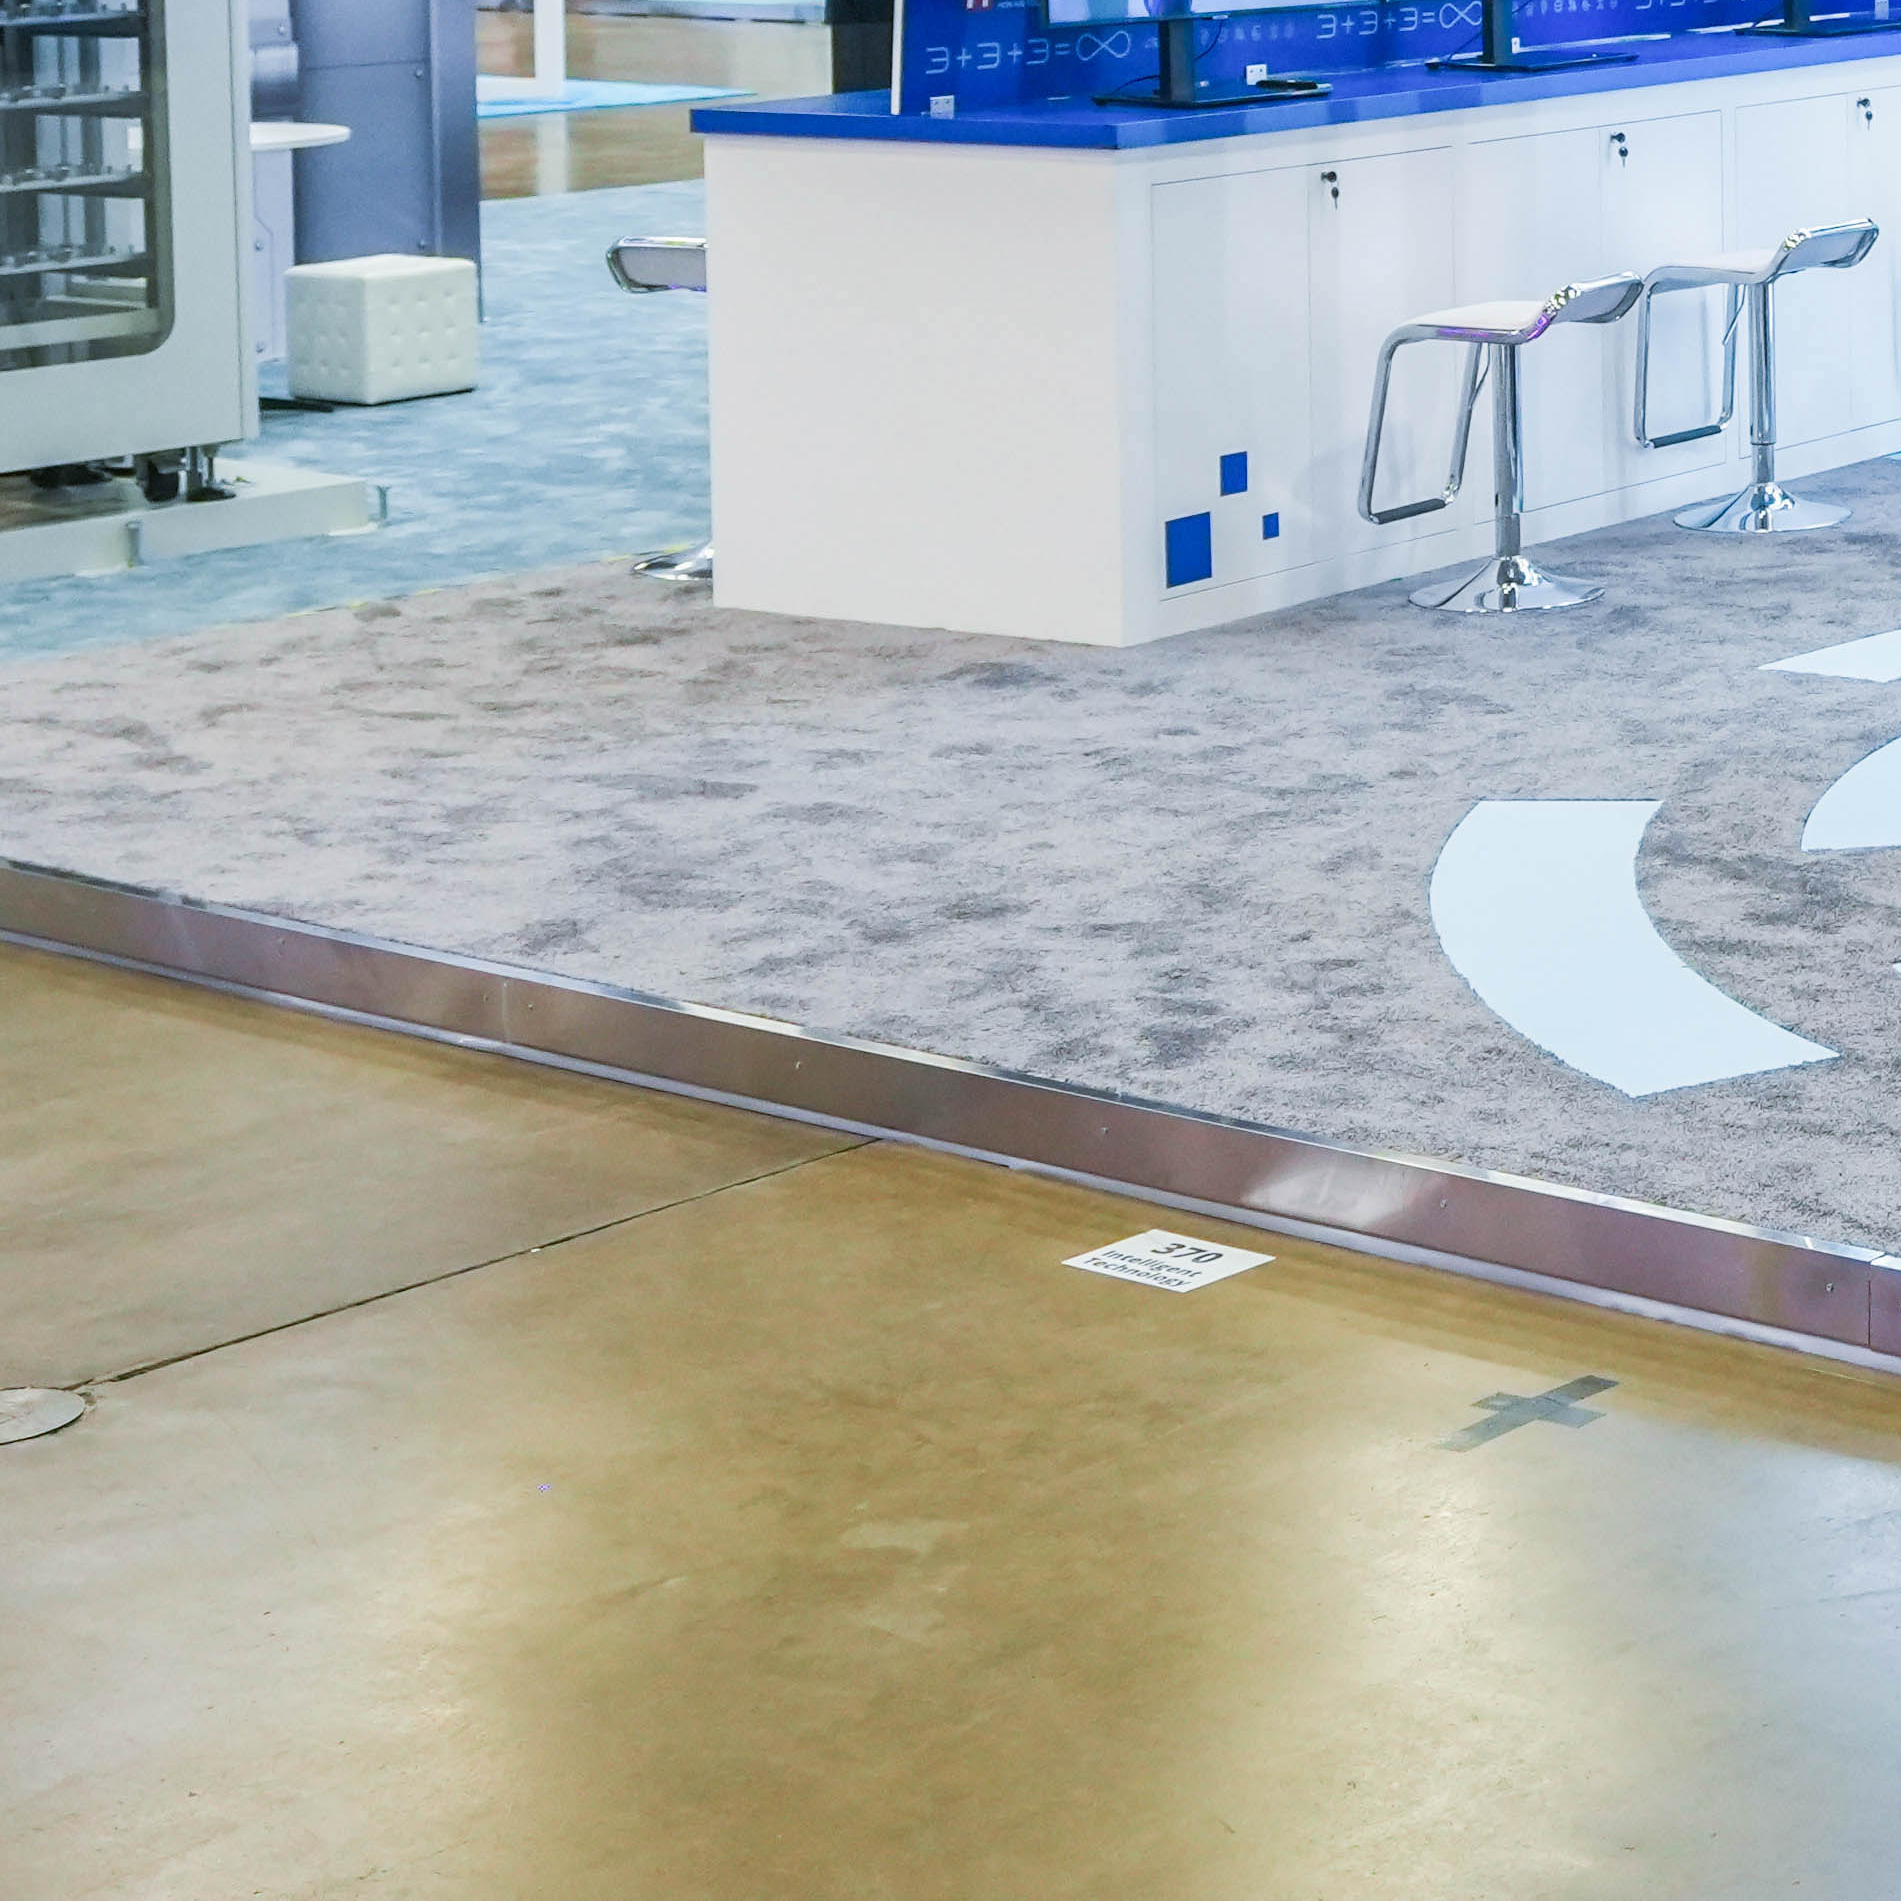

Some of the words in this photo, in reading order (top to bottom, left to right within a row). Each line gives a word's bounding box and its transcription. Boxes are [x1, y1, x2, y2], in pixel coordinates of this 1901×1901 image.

[1101, 1249, 1203, 1279] Intelligent
[1150, 1242, 1225, 1265] 370
[1085, 1256, 1191, 1289] Technology
